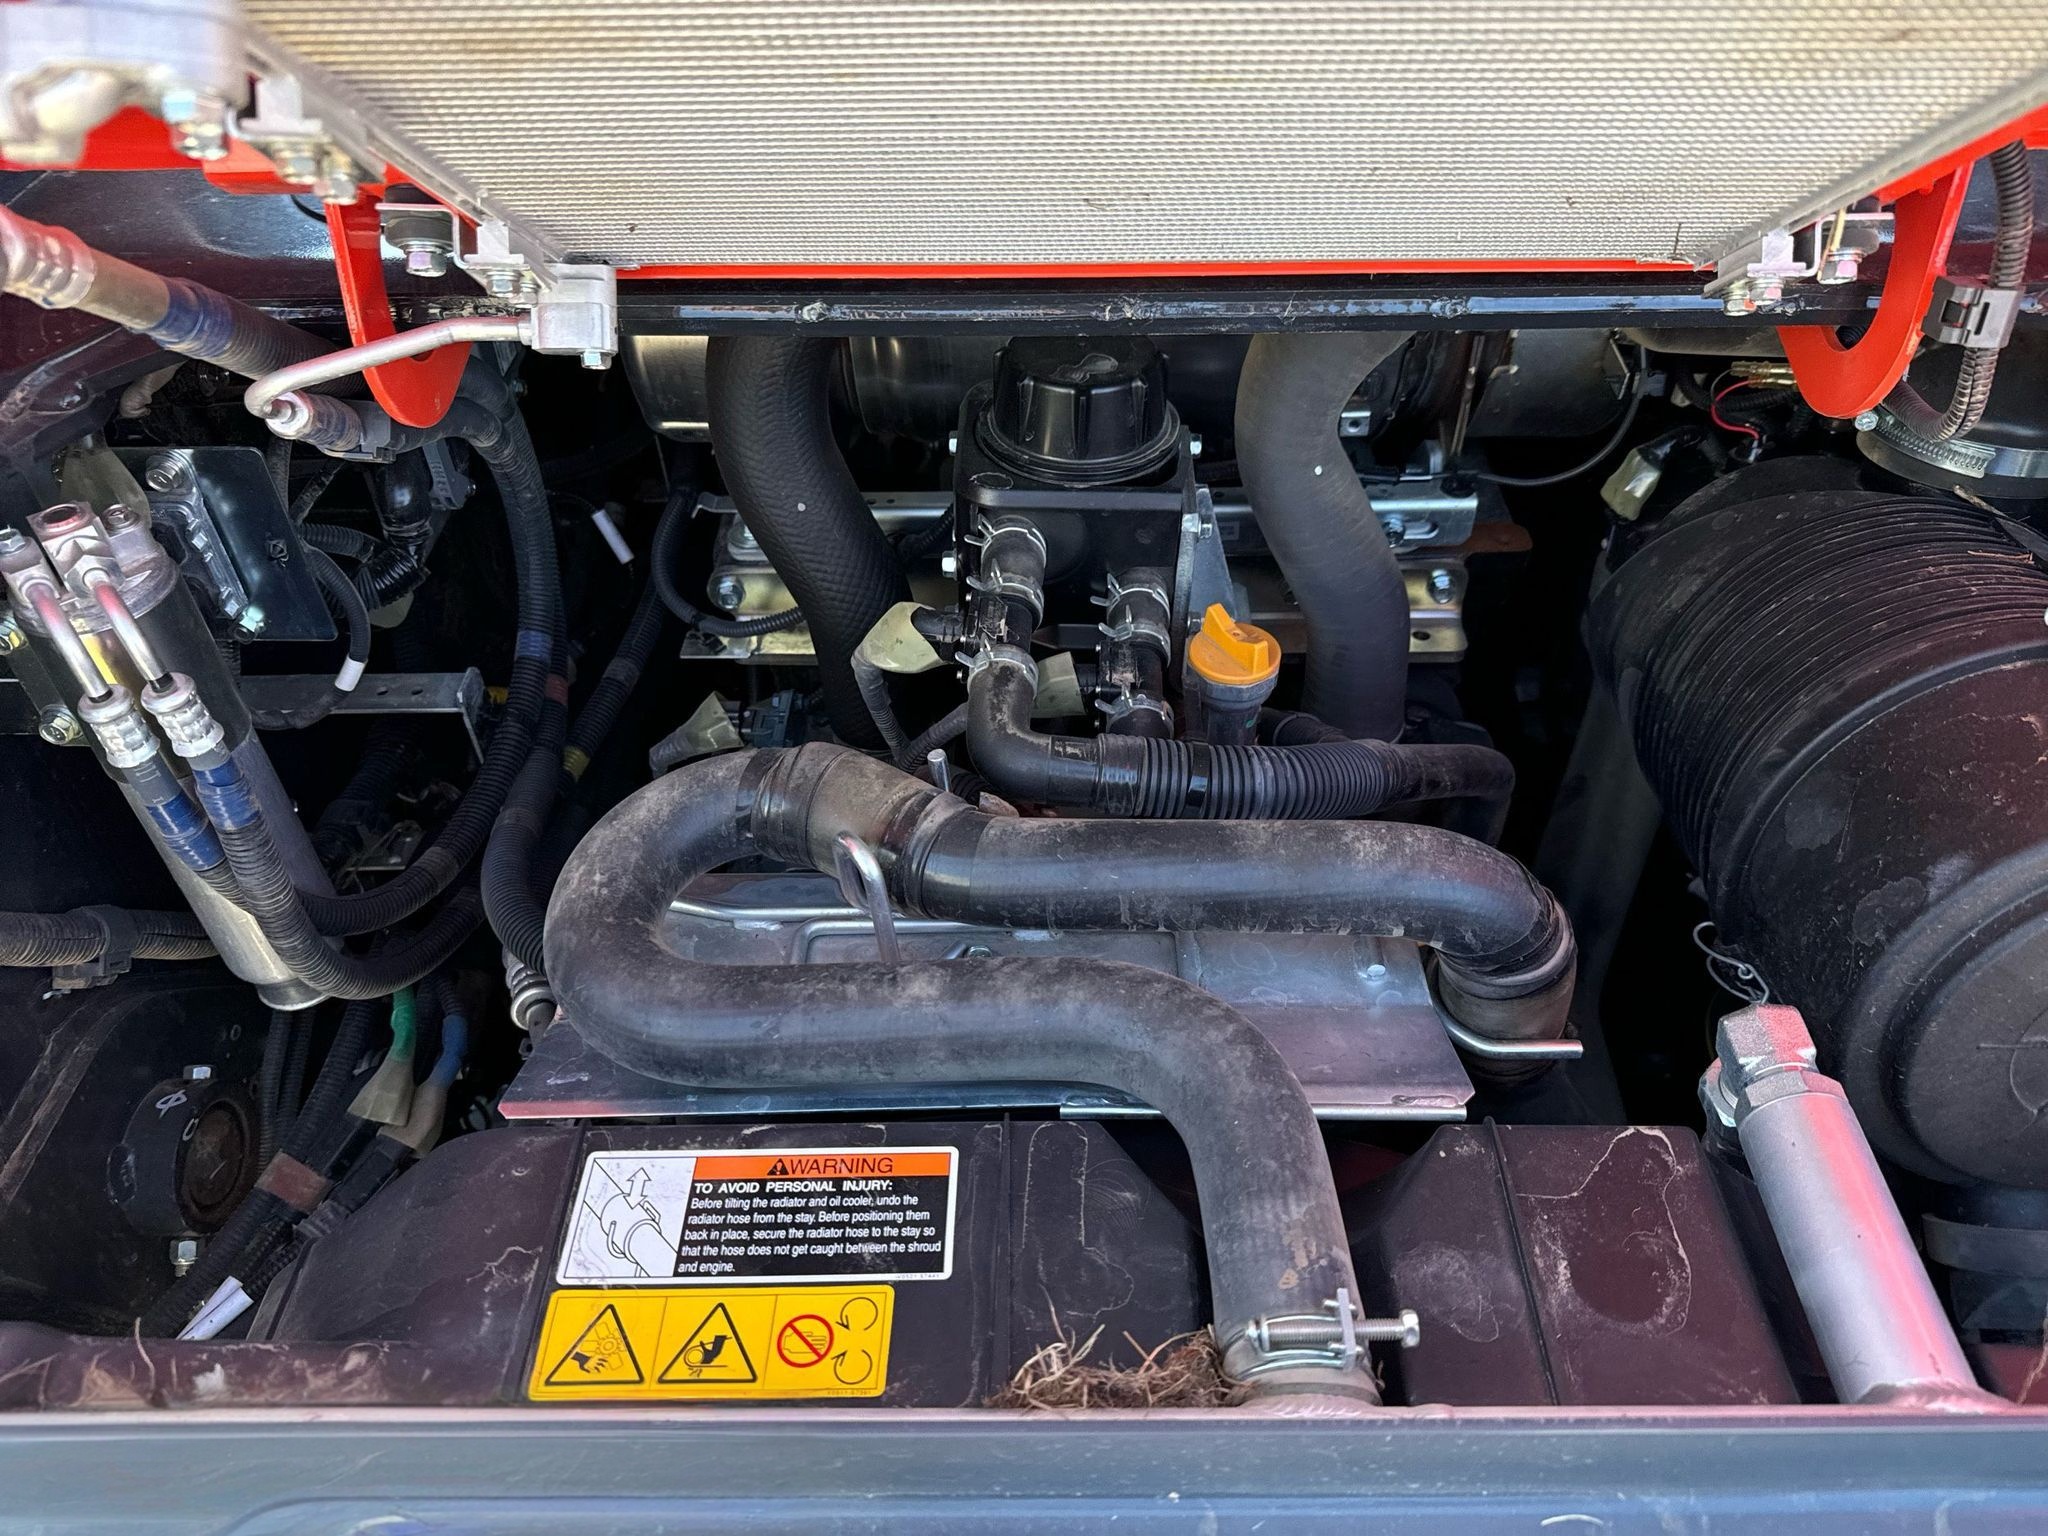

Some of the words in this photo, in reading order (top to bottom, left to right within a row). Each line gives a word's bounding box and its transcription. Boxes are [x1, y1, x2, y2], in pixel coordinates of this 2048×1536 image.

[790, 1157, 894, 1175] WARNING
[694, 1182, 714, 1194] TO
[718, 1182, 760, 1194] AVOID
[765, 1180, 836, 1192] PERSONAL
[842, 1180, 893, 1191] INJURY:
[690, 1198, 722, 1209] Before
[724, 1198, 750, 1211] tilting
[752, 1197, 768, 1208] the
[770, 1196, 806, 1208] radiator
[808, 1196, 828, 1207] and
[829, 1196, 840, 1206] oil
[877, 1194, 901, 1206] undo
[902, 1194, 919, 1205] the
[687, 1213, 726, 1224] radiator
[726, 1212, 750, 1224] hose
[752, 1212, 775, 1224] from
[777, 1212, 793, 1223] the
[794, 1212, 816, 1225] stay.
[818, 1210, 850, 1222] Before
[851, 1210, 904, 1224] positioning
[906, 1210, 930, 1220] them
[684, 1229, 708, 1240] back
[710, 1229, 720, 1240] in
[720, 1228, 750, 1242] place,
[752, 1229, 787, 1240] secure
[788, 1228, 804, 1238] the
[806, 1226, 844, 1238] radiator
[845, 1226, 870, 1238] hose
[872, 1226, 881, 1237] to
[883, 1226, 900, 1237] the
[901, 1226, 921, 1238] stay
[922, 1226, 936, 1236] so
[681, 1245, 702, 1256] that
[702, 1245, 719, 1256] the
[720, 1244, 746, 1256] hose
[747, 1244, 772, 1256] does
[774, 1244, 790, 1255] not
[791, 1244, 808, 1257] get
[810, 1242, 844, 1257] caught
[845, 1242, 888, 1254] between
[890, 1242, 906, 1253] the
[907, 1240, 942, 1252] shroud
[678, 1261, 698, 1272] and
[700, 1260, 736, 1275] engine.
